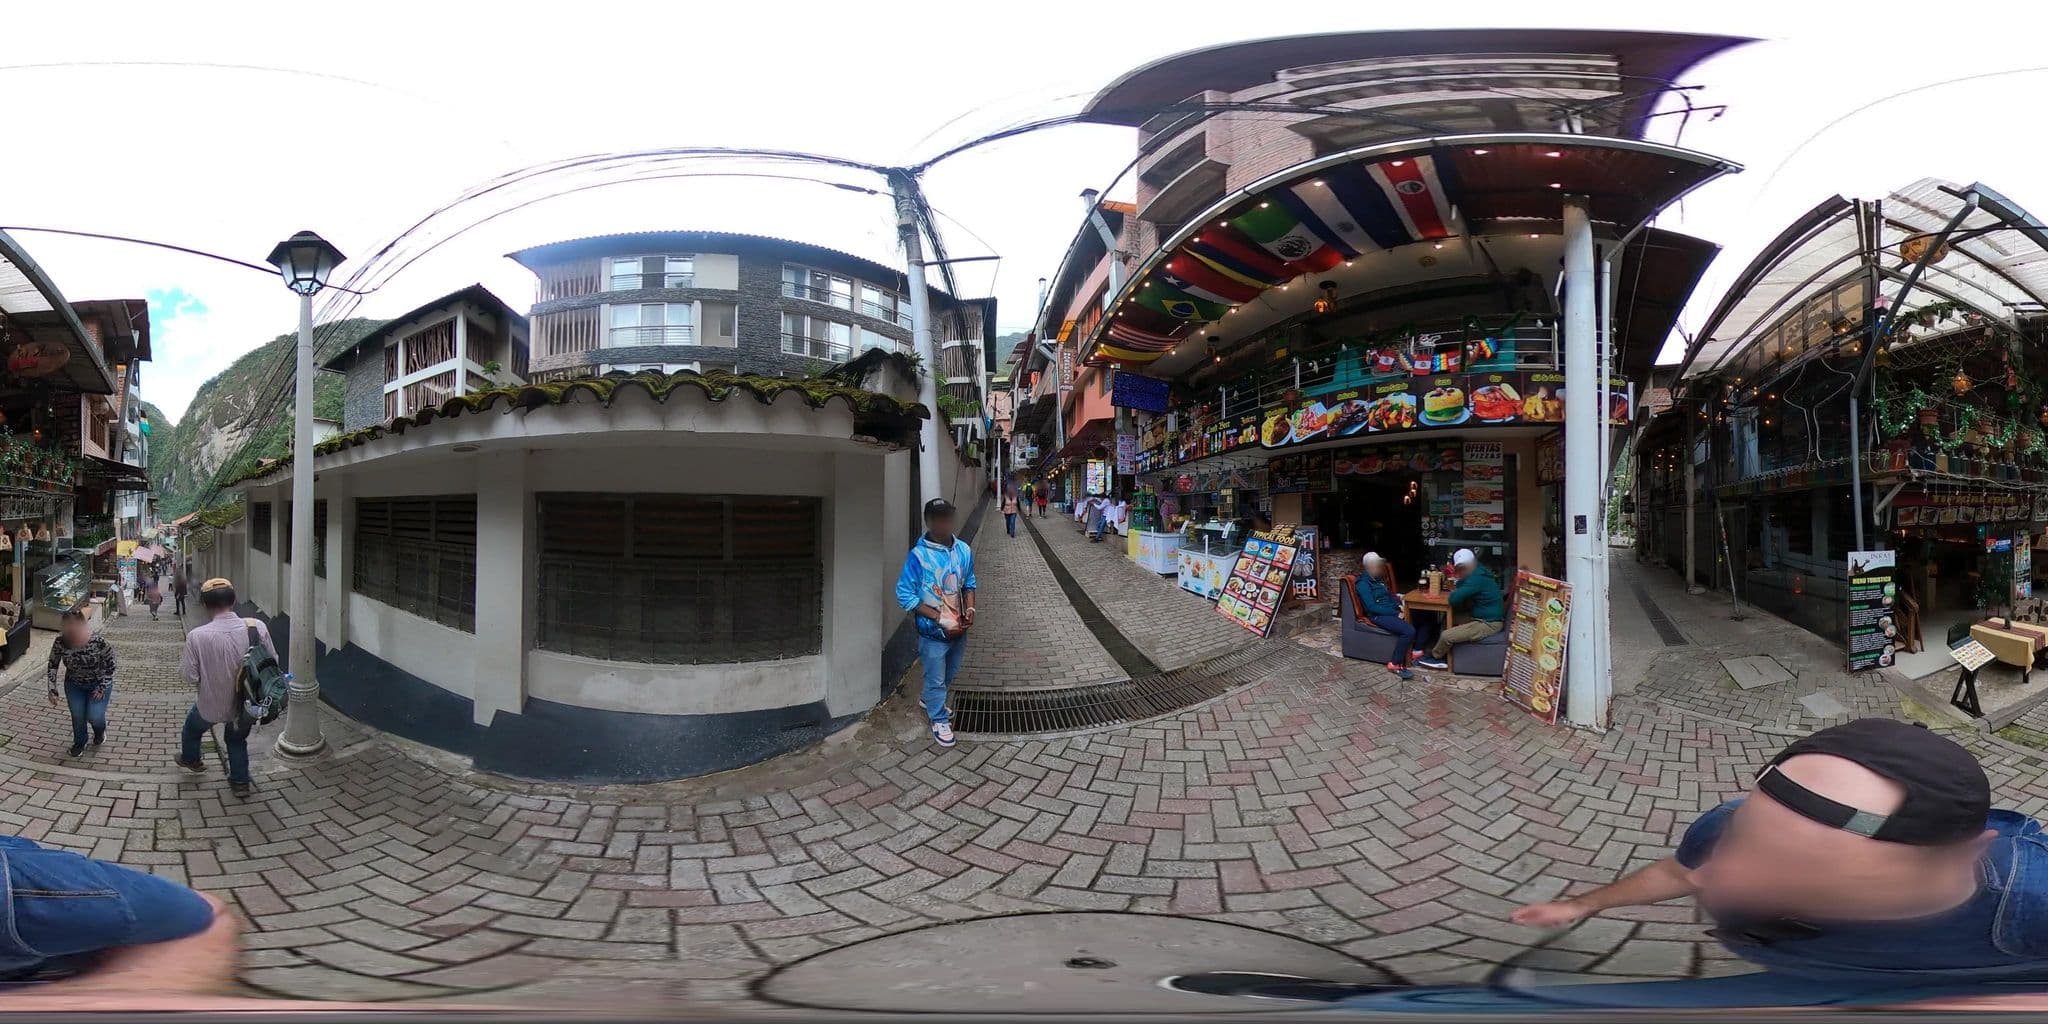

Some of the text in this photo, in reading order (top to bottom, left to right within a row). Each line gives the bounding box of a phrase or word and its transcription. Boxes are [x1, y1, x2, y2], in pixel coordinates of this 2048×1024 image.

[1465, 443, 1501, 453] OFERTAS
[1253, 530, 1275, 541] TYPICAL
[1275, 535, 1296, 545] FOOD
